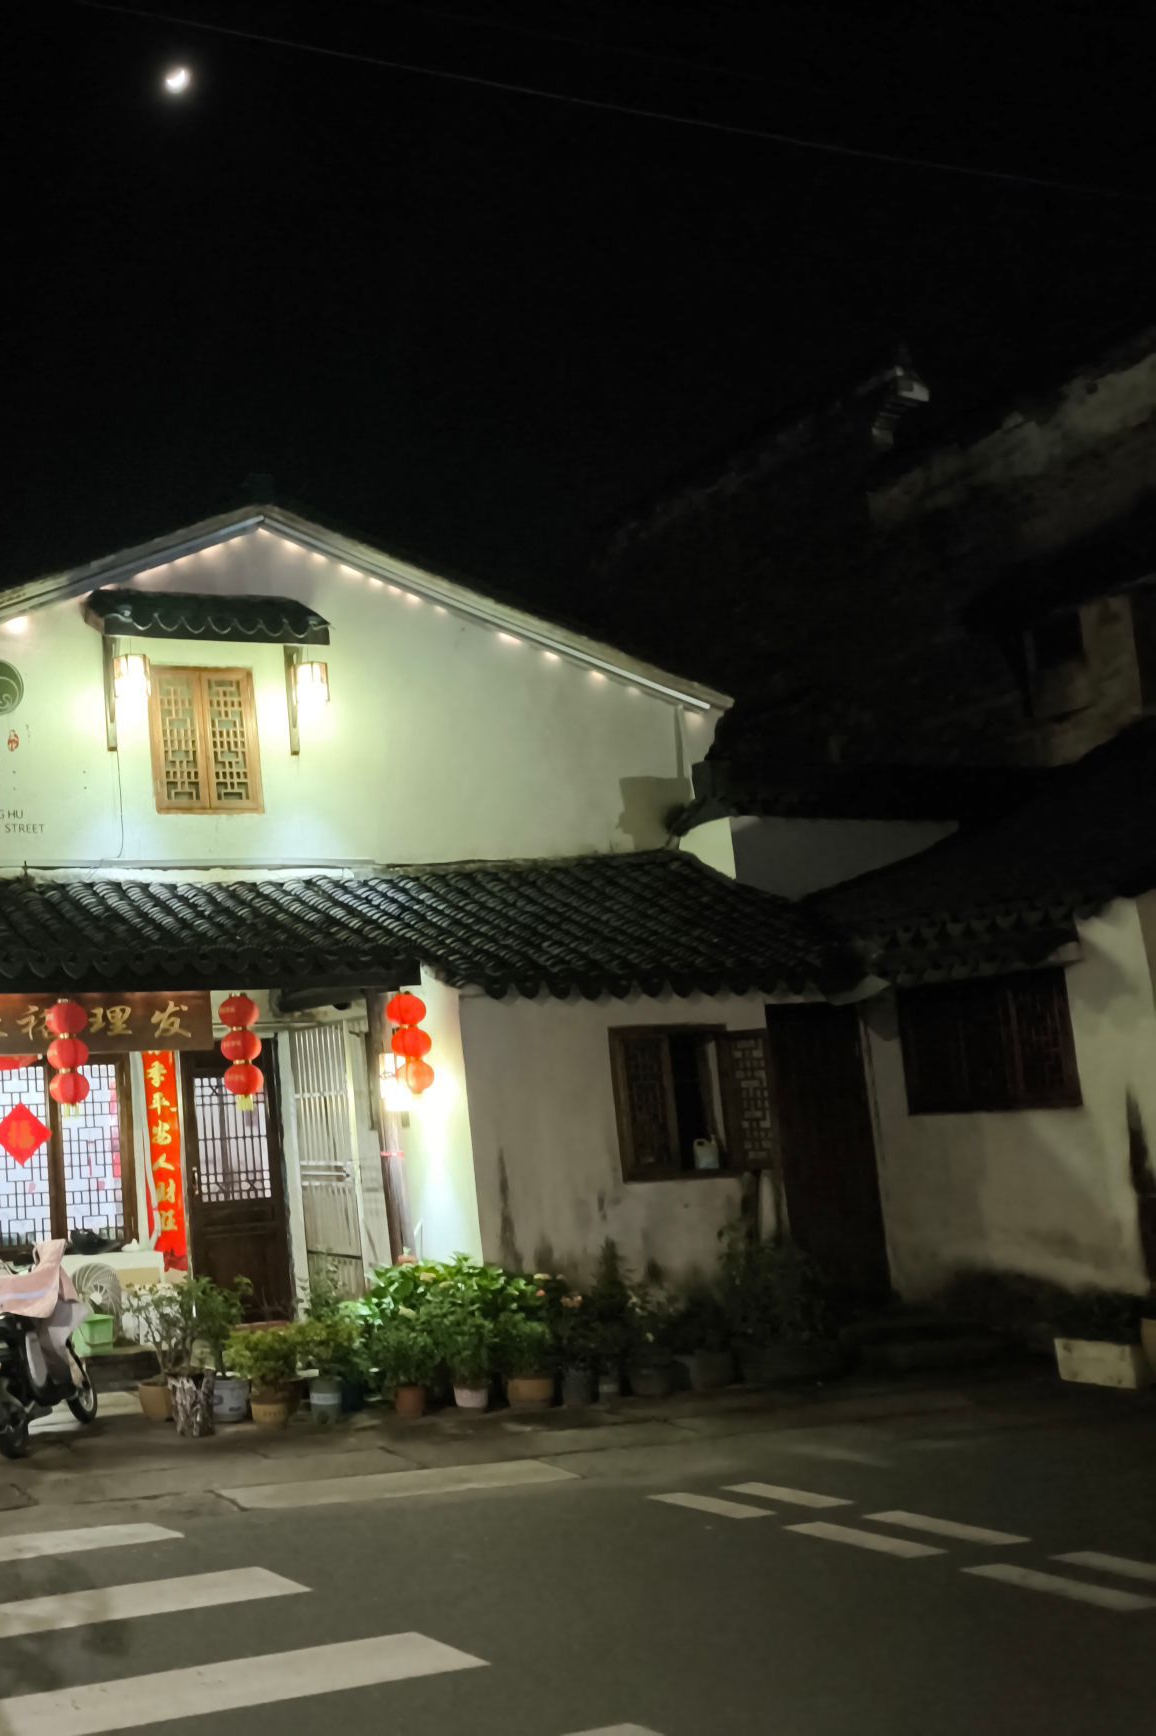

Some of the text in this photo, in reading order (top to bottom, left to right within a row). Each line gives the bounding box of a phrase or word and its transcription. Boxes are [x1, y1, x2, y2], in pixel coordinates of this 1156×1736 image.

[7, 809, 23, 819] HU
[5, 823, 44, 834] STREET
[146, 1050, 178, 1231] 季平安人财旺
